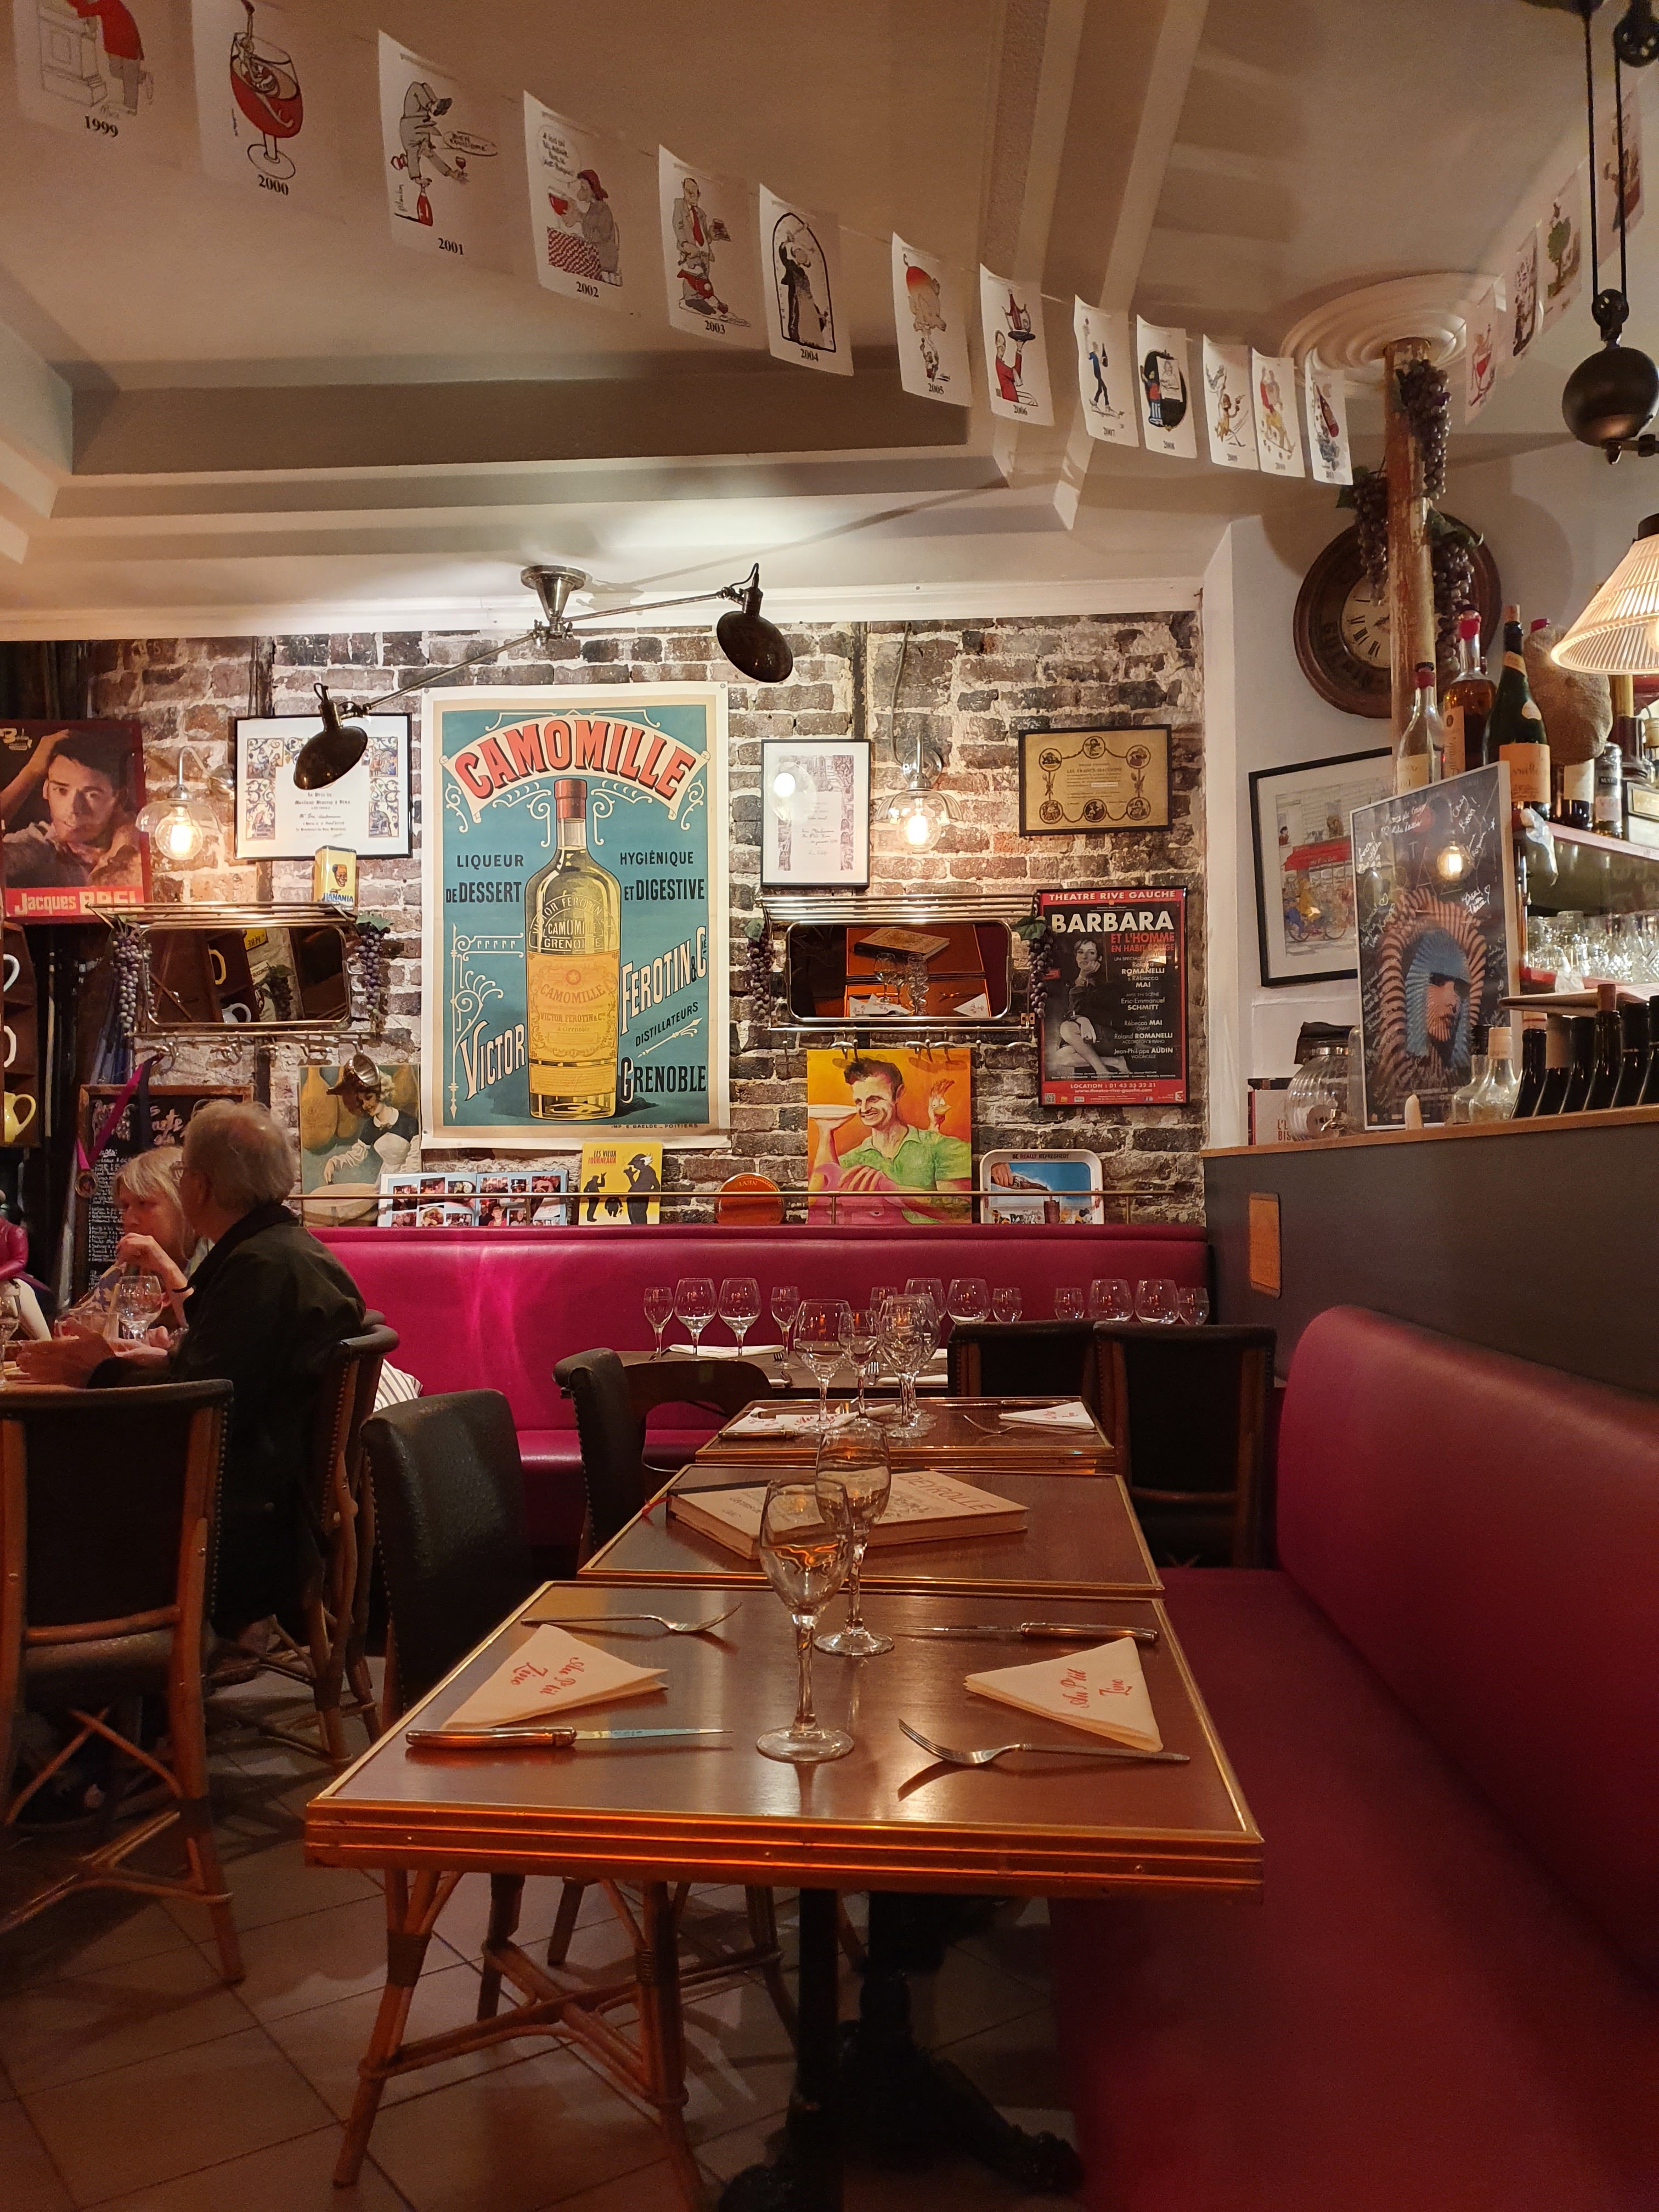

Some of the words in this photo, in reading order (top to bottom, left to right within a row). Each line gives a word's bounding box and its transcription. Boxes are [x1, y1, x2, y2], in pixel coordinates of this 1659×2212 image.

[85, 115, 119, 138] 1999
[258, 173, 289, 195] 2000
[438, 238, 464, 255] 2001
[576, 281, 599, 298] 2002
[704, 320, 725, 335] 2003
[800, 348, 819, 362] 2004
[928, 383, 945, 395] 2005
[1013, 404, 1028, 416] 2006
[455, 719, 697, 801] CAMOMILLE
[456, 854, 524, 868] LIQUEUR
[446, 889, 457, 904] DE
[459, 881, 522, 904] DESSERT
[624, 885, 634, 901] ET
[636, 878, 705, 901] DIGESTIVE
[1049, 891, 1095, 901] THEATRE
[1100, 891, 1124, 900] RIVE
[1129, 890, 1176, 899] GAUCHE
[14, 893, 76, 915] Jacques
[1051, 911, 1174, 933] BARBARA
[1110, 933, 1121, 944] ET
[1125, 932, 1175, 944] L'HOMME
[1111, 945, 1121, 953] EN
[1124, 944, 1146, 952] HABIT
[540, 984, 606, 1005] CAMOMILLE
[460, 1019, 526, 1101] VICTOR
[620, 938, 691, 1037] FEROTIN
[540, 1012, 563, 1023] VICTOR
[565, 1013, 593, 1023] FEROTIN
[636, 1001, 699, 1048] DISTILLATEURS
[620, 1056, 707, 1103] GRENOBLE
[898, 1475, 997, 1510] DEYROLLE
